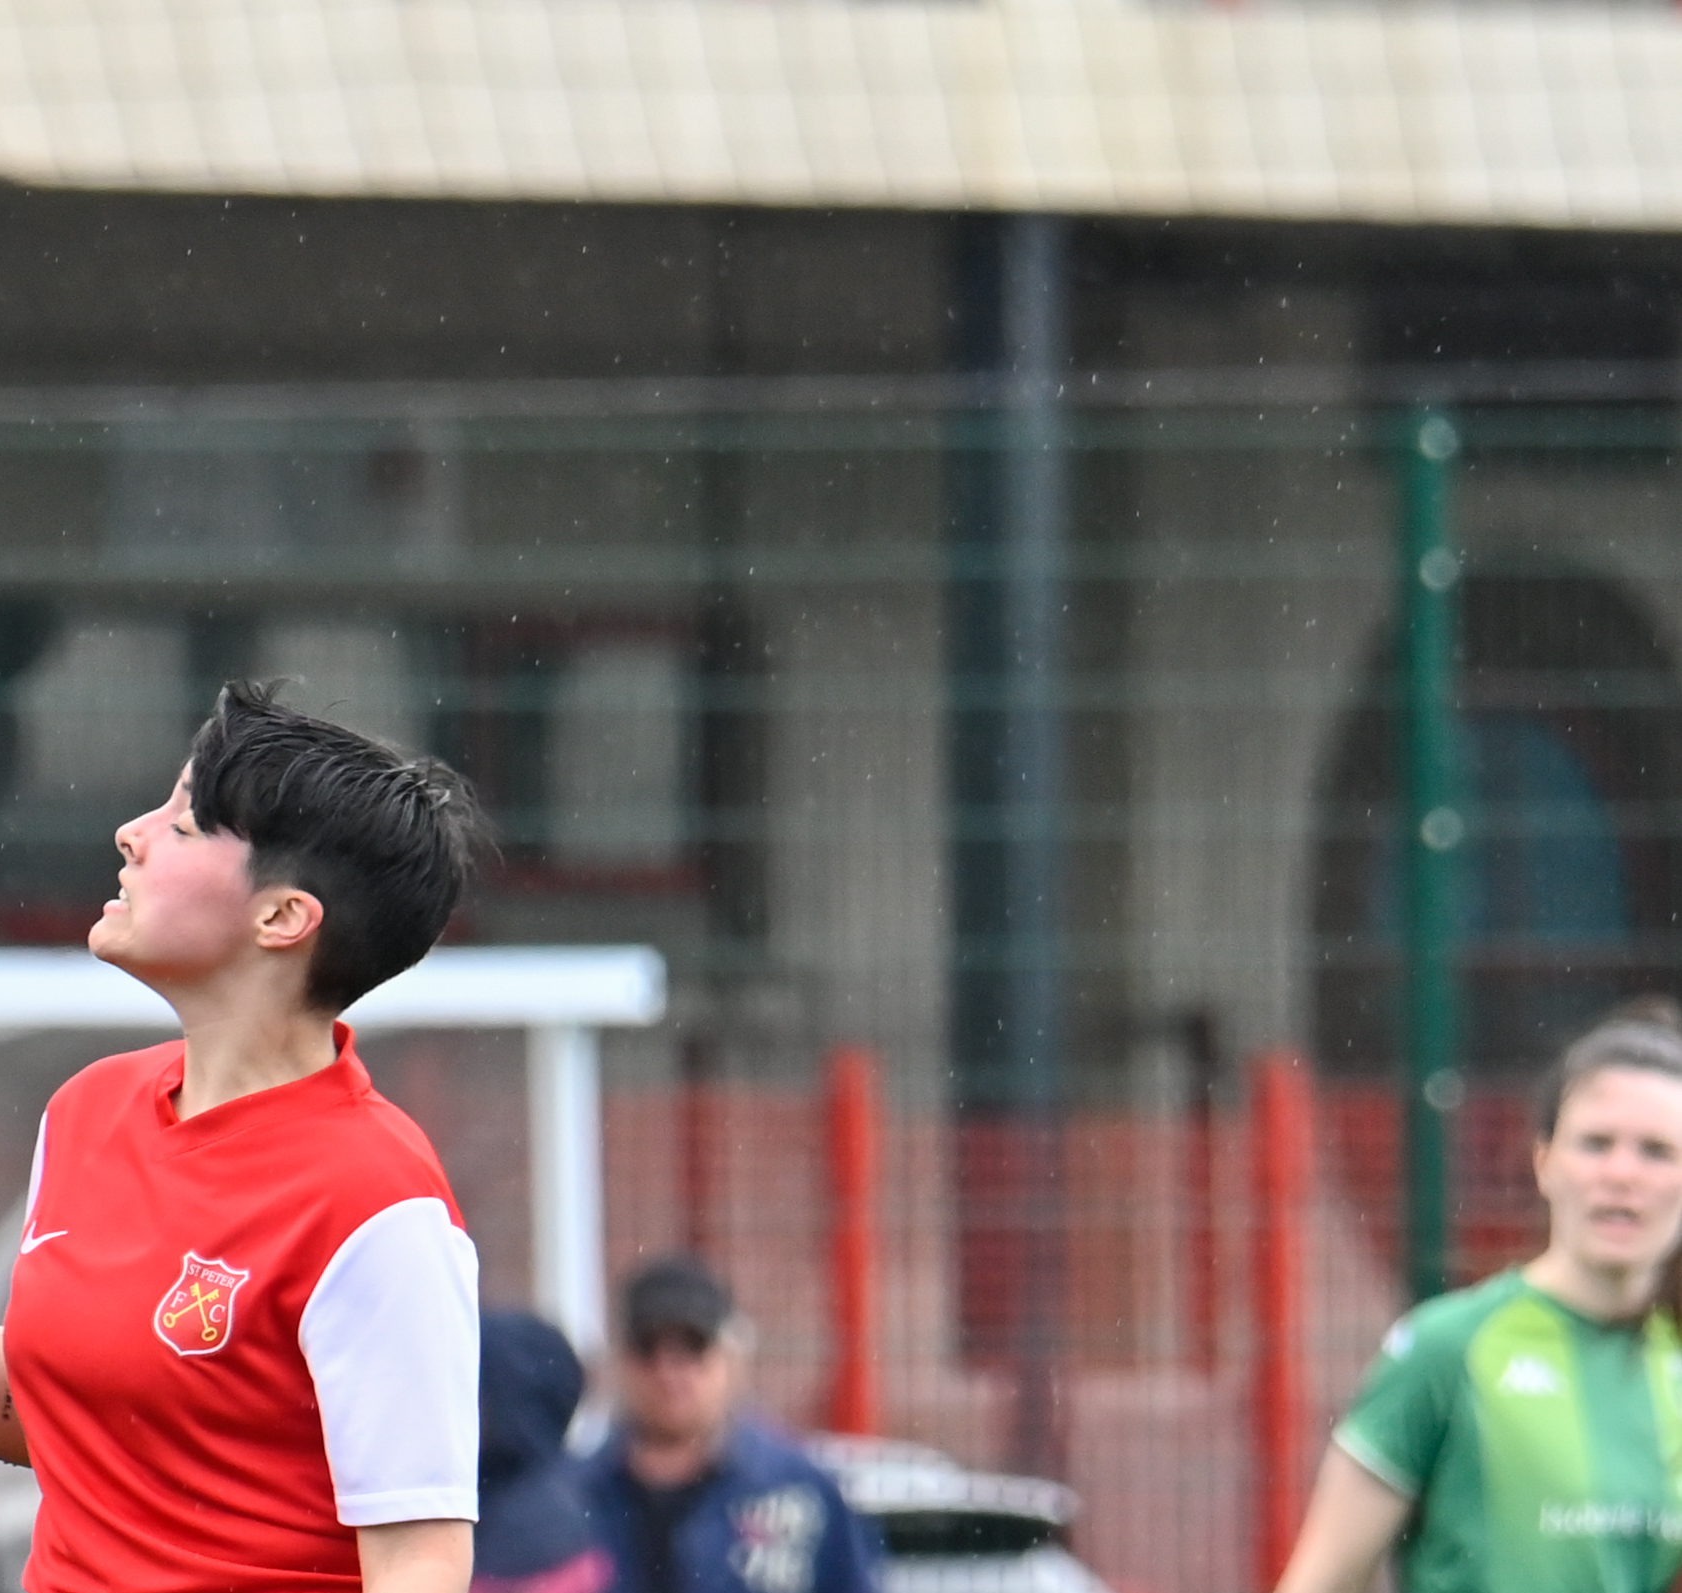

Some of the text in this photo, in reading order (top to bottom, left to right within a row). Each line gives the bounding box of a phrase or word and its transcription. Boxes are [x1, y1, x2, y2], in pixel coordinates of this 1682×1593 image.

[200, 1267, 236, 1289] PETER
[169, 1290, 226, 1323] F C
